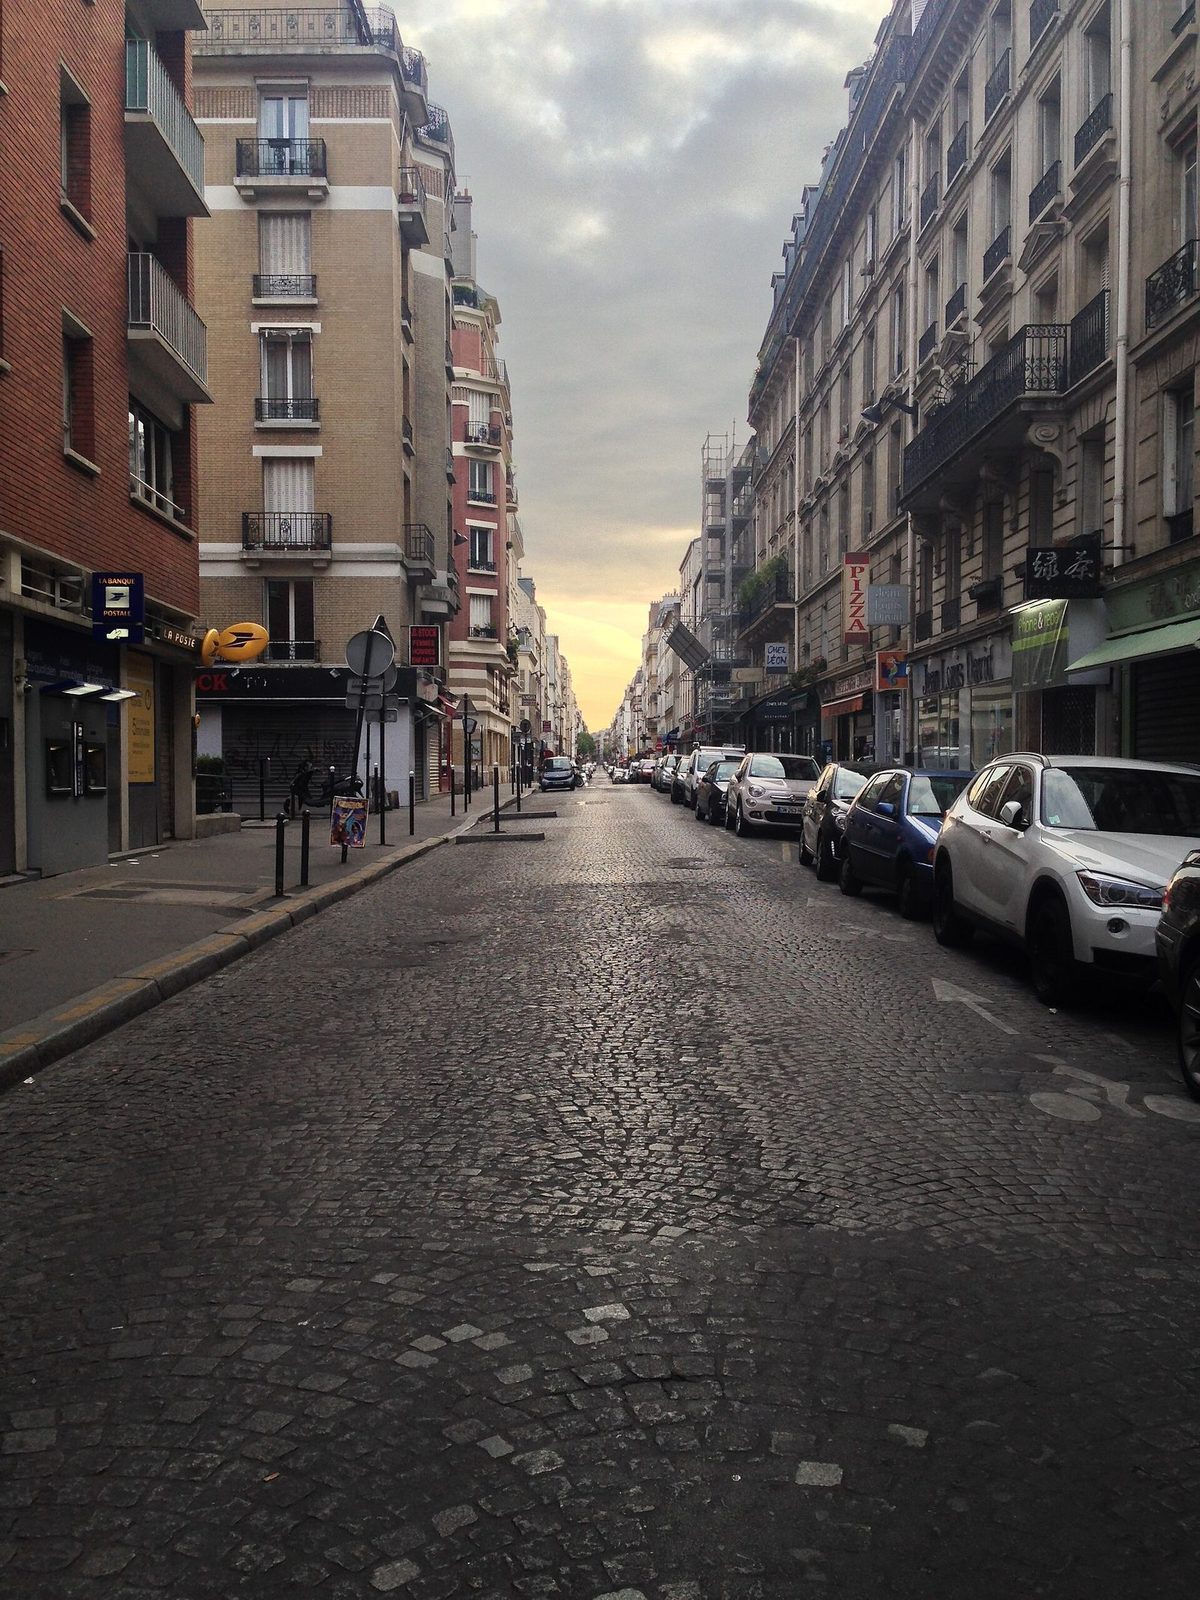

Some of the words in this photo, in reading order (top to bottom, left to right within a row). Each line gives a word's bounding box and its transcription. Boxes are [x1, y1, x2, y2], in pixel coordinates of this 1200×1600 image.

[108, 578, 136, 586] BANQUE
[849, 566, 867, 631] PIZZA
[163, 628, 173, 639] LA
[175, 633, 196, 648] POSTE
[767, 645, 787, 655] CHEZ
[767, 654, 788, 665] LÉON
[196, 674, 229, 691] CK
[922, 663, 941, 695] Jean
[941, 656, 965, 690] Louis
